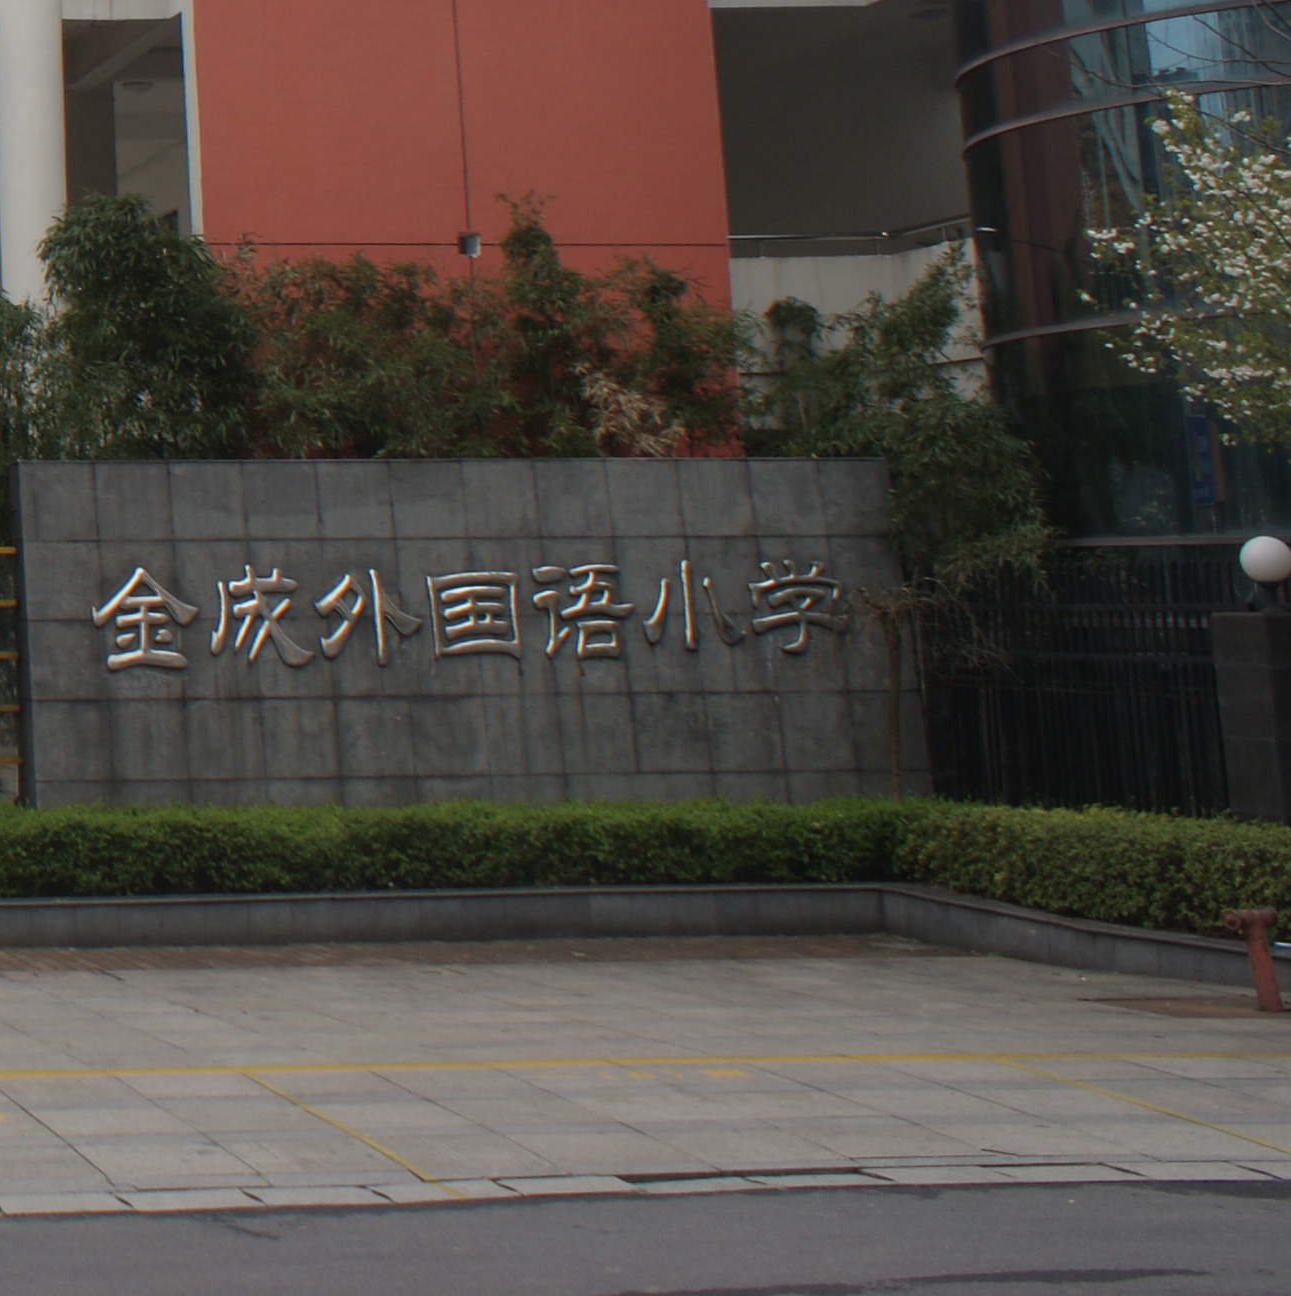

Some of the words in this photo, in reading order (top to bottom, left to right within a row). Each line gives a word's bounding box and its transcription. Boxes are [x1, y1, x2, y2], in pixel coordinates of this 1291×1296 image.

[91, 558, 849, 673] 金成外国语小学
